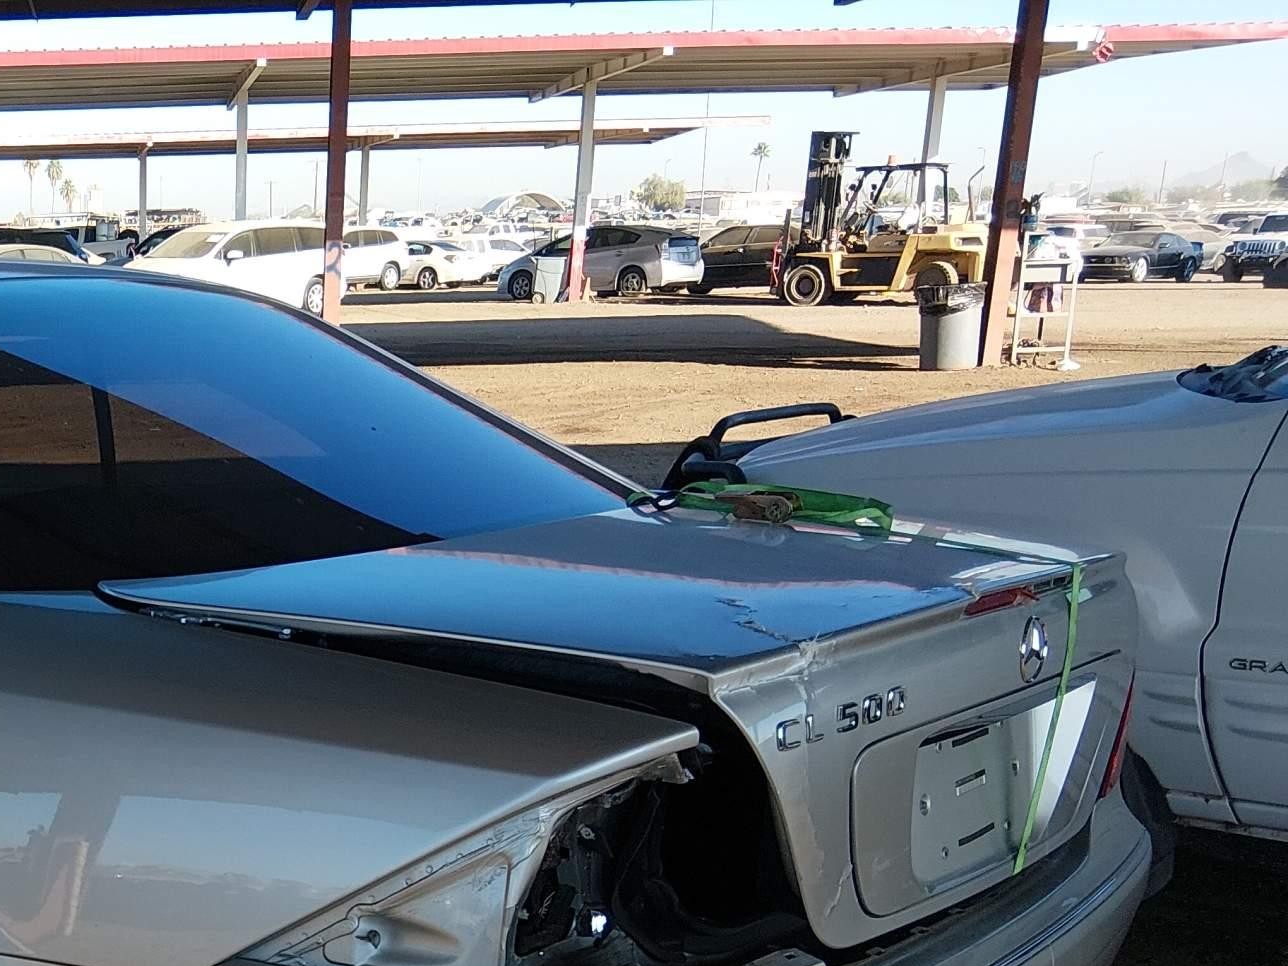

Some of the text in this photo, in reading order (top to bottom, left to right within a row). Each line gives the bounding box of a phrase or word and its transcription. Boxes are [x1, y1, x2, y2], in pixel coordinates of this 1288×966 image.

[1229, 657, 1288, 674] GRA
[775, 685, 905, 752] CL 500
